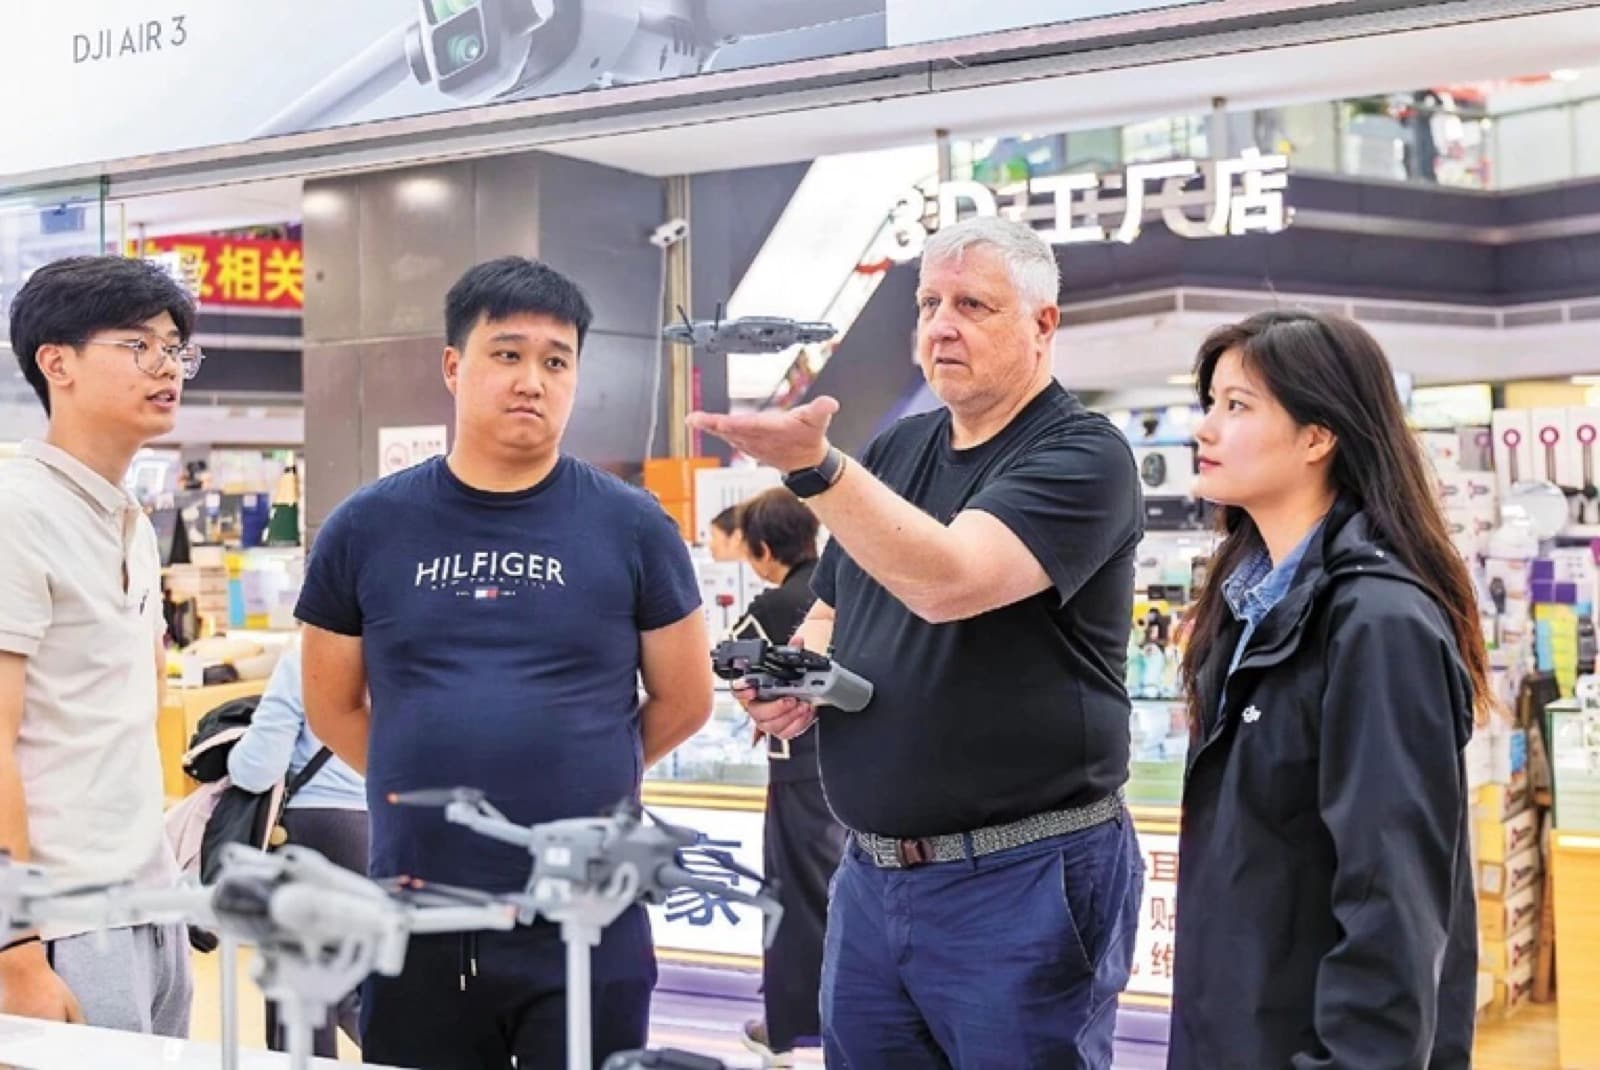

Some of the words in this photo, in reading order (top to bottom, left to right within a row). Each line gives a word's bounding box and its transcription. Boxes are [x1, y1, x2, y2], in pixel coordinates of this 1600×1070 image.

[73, 29, 112, 63] DJI
[119, 20, 162, 56] AIR
[170, 14, 188, 47] 3
[414, 550, 565, 588] HILFIGER
